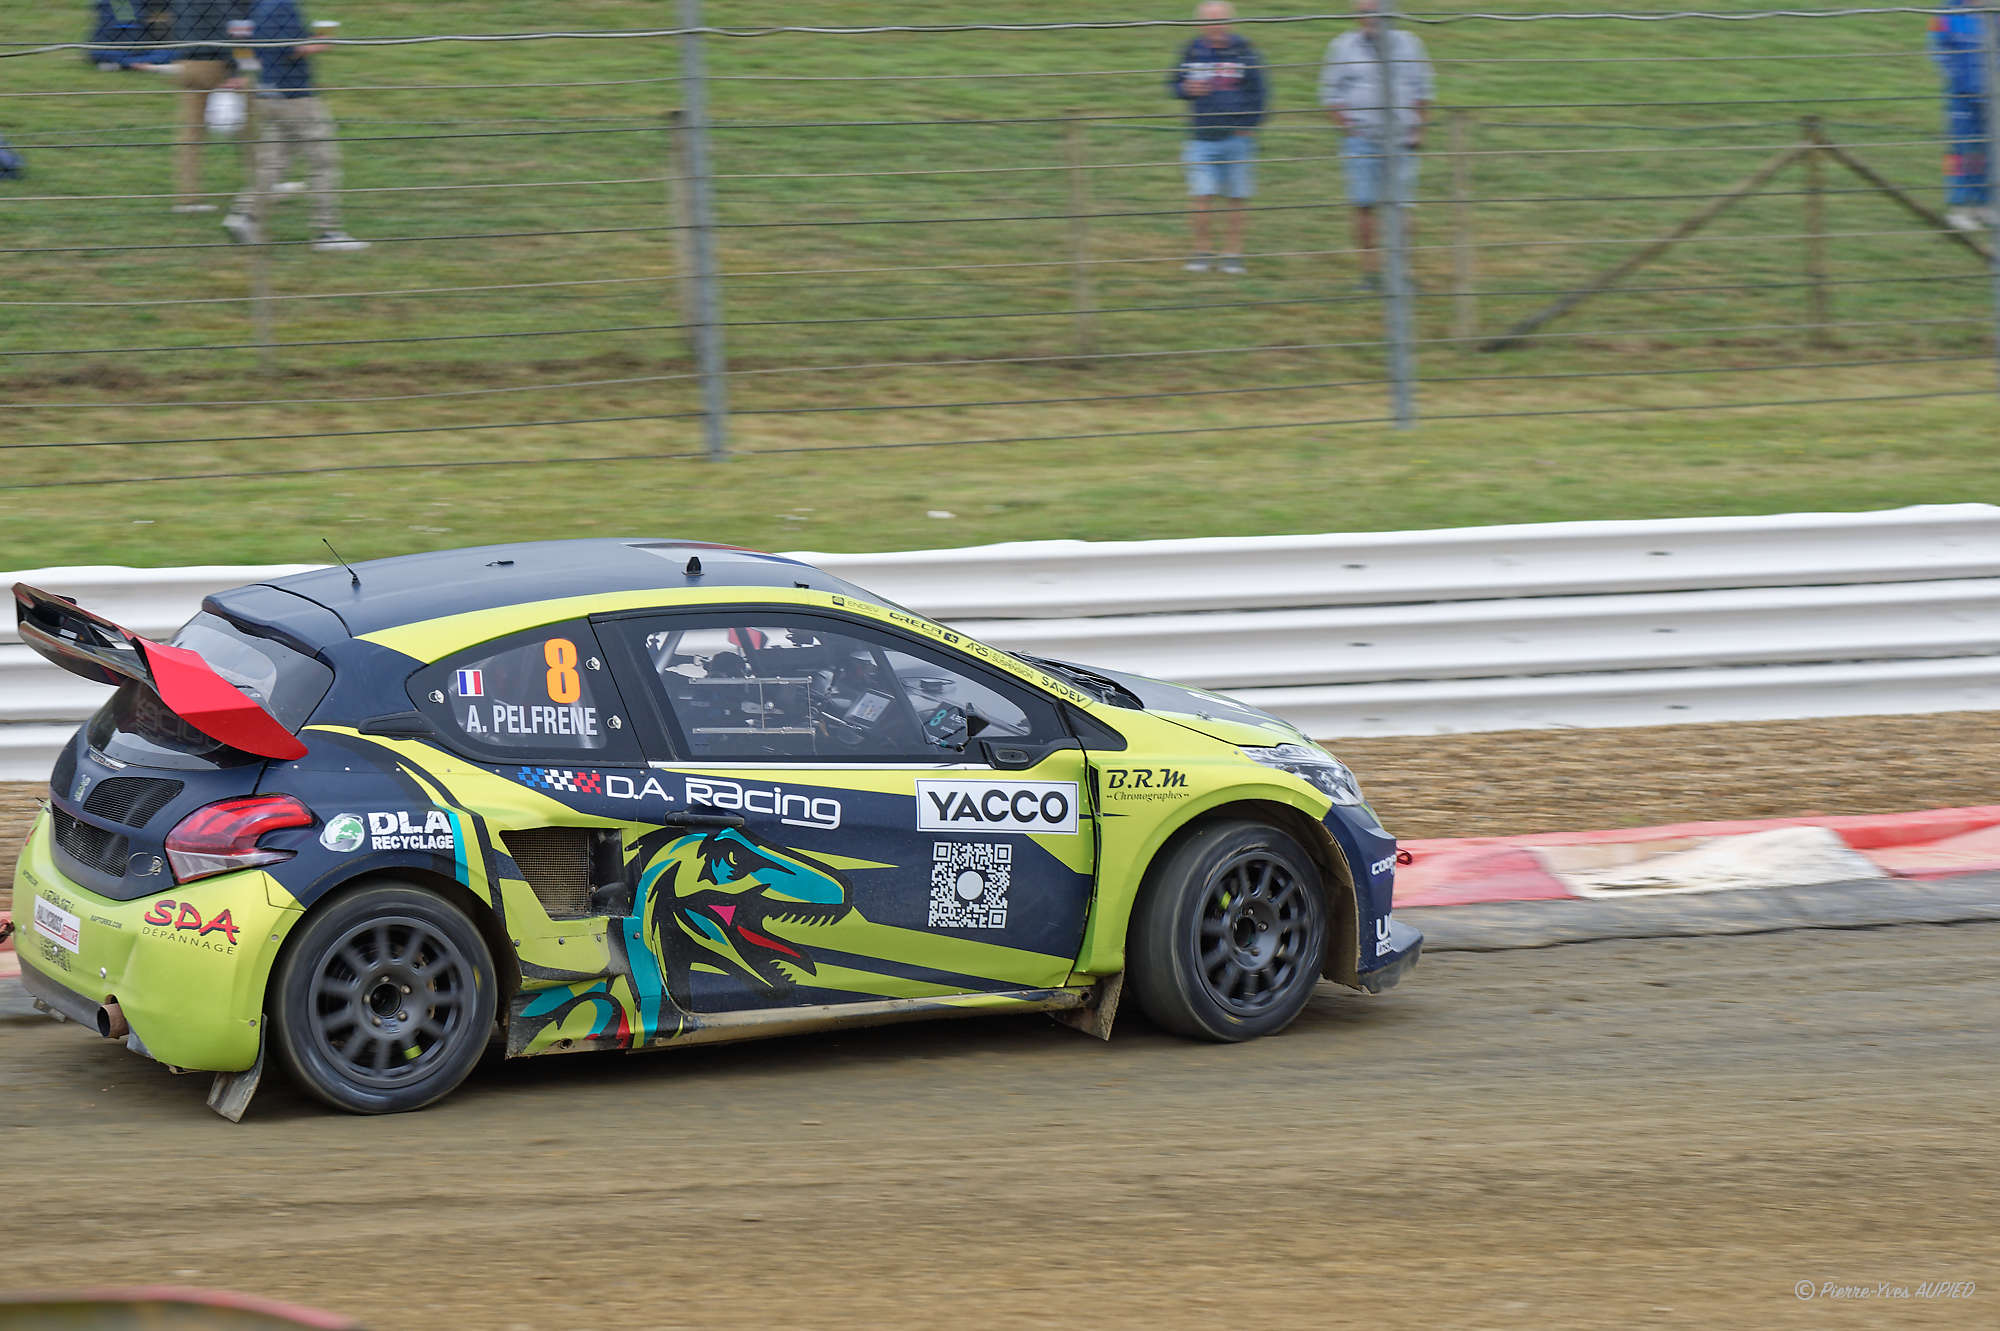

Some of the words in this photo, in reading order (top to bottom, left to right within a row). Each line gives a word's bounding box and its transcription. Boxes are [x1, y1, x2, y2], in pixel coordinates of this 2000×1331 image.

[544, 638, 581, 704] 8
[1041, 675, 1086, 703] SADEV
[466, 704, 487, 733] A.
[493, 705, 598, 736] PELFRENE
[605, 775, 675, 802] D.A.
[685, 777, 841, 831] Racing
[927, 789, 1069, 824] YACCO
[367, 811, 453, 836] DLA
[371, 835, 455, 850] RECYCLAGE
[143, 899, 241, 946] SDA
